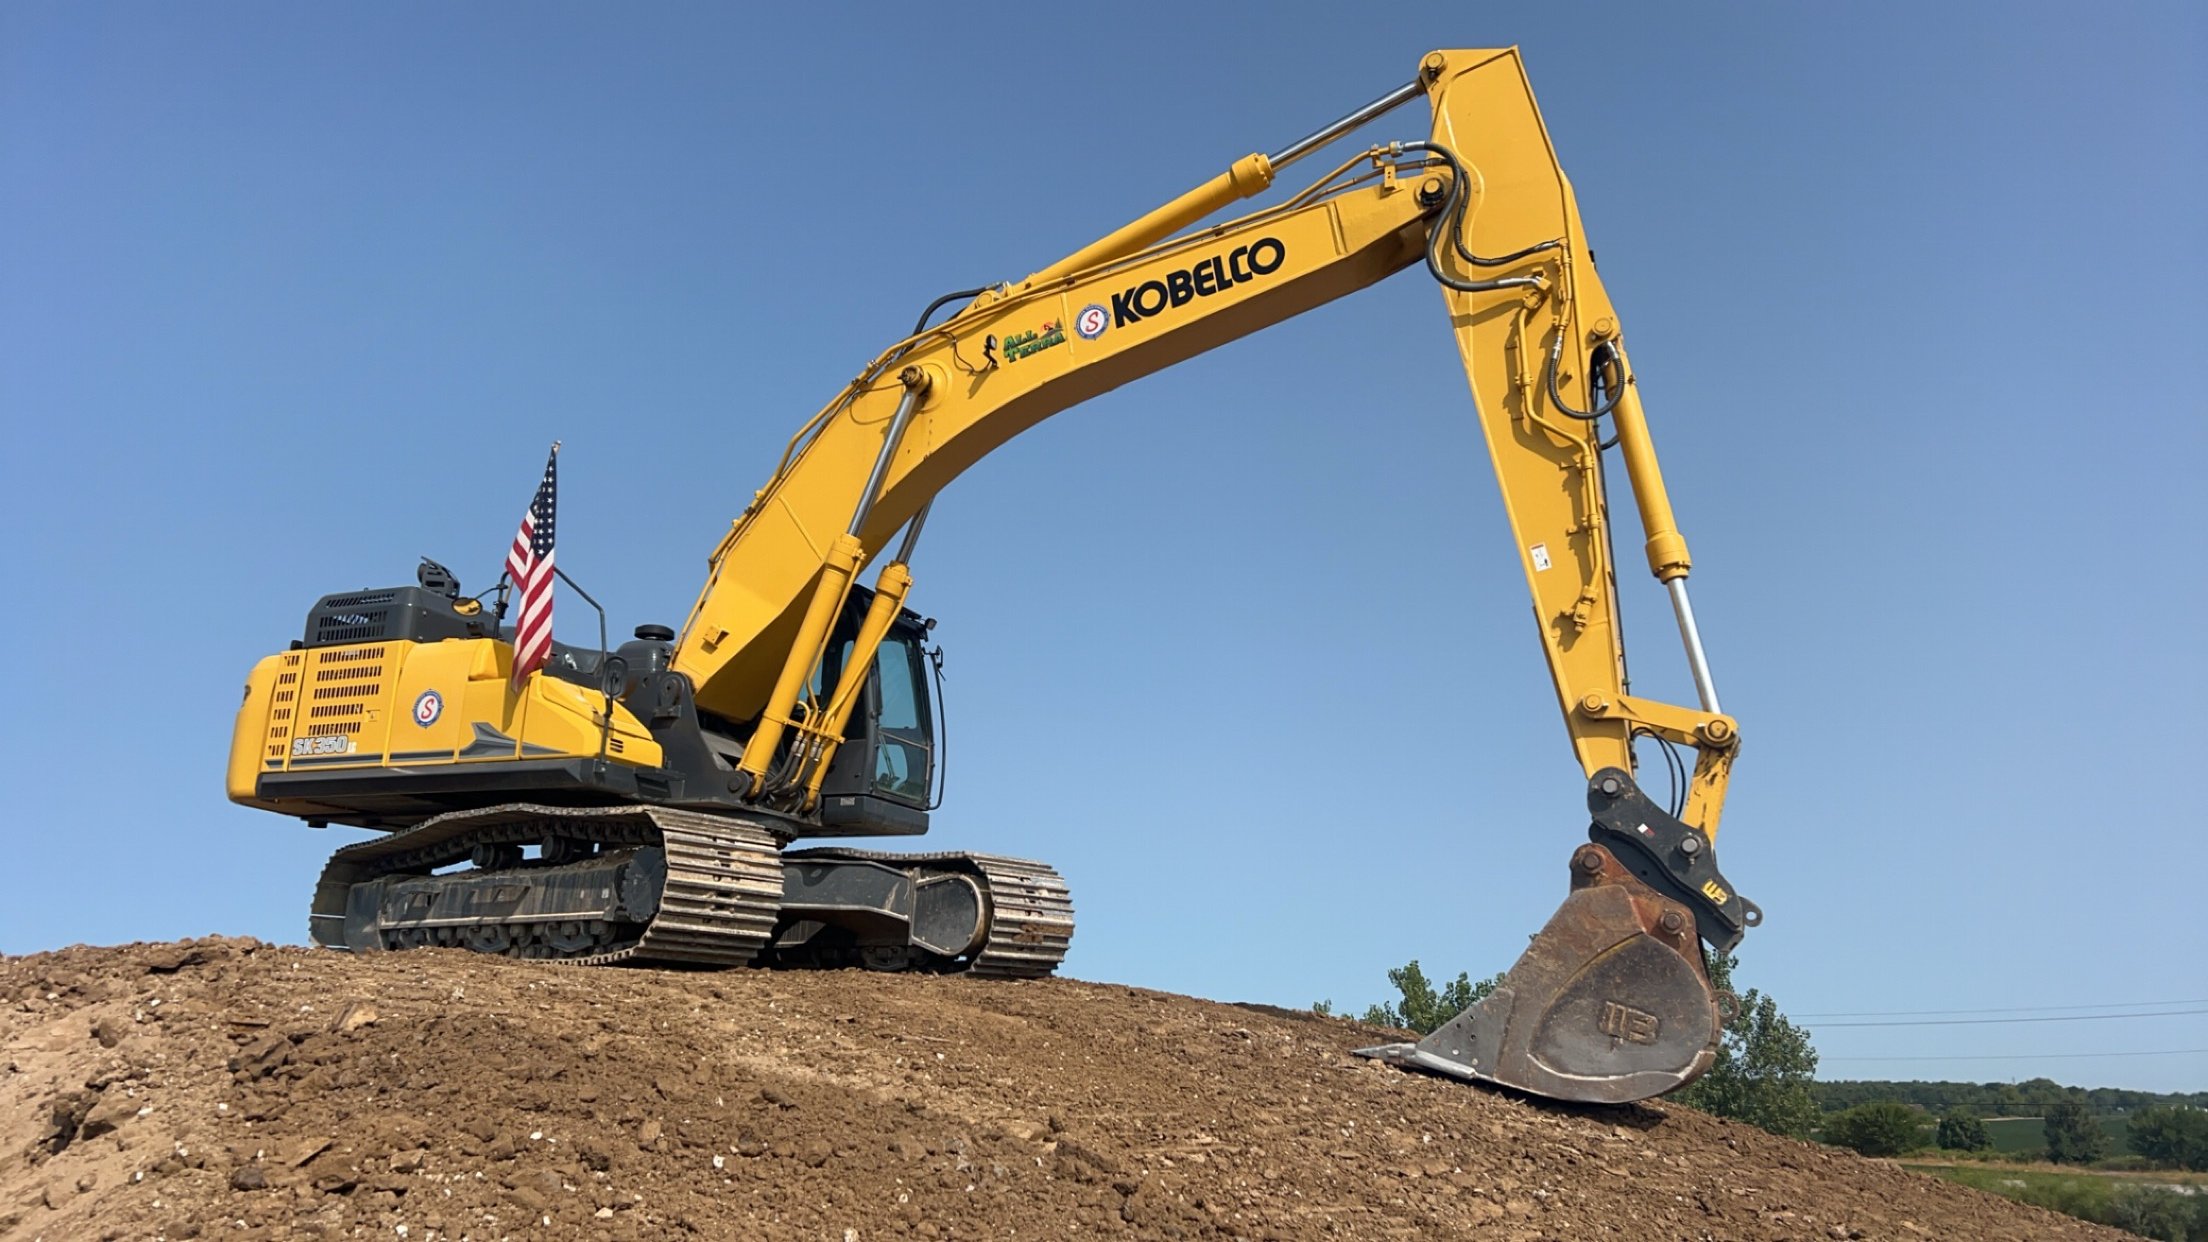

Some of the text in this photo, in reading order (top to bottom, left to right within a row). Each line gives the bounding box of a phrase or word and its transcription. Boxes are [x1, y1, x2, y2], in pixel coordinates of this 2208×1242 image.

[1111, 237, 1286, 328] KOBELCO
[1003, 329, 1038, 350] ALL
[1004, 332, 1066, 363] TERRA
[292, 735, 348, 755] SK350
